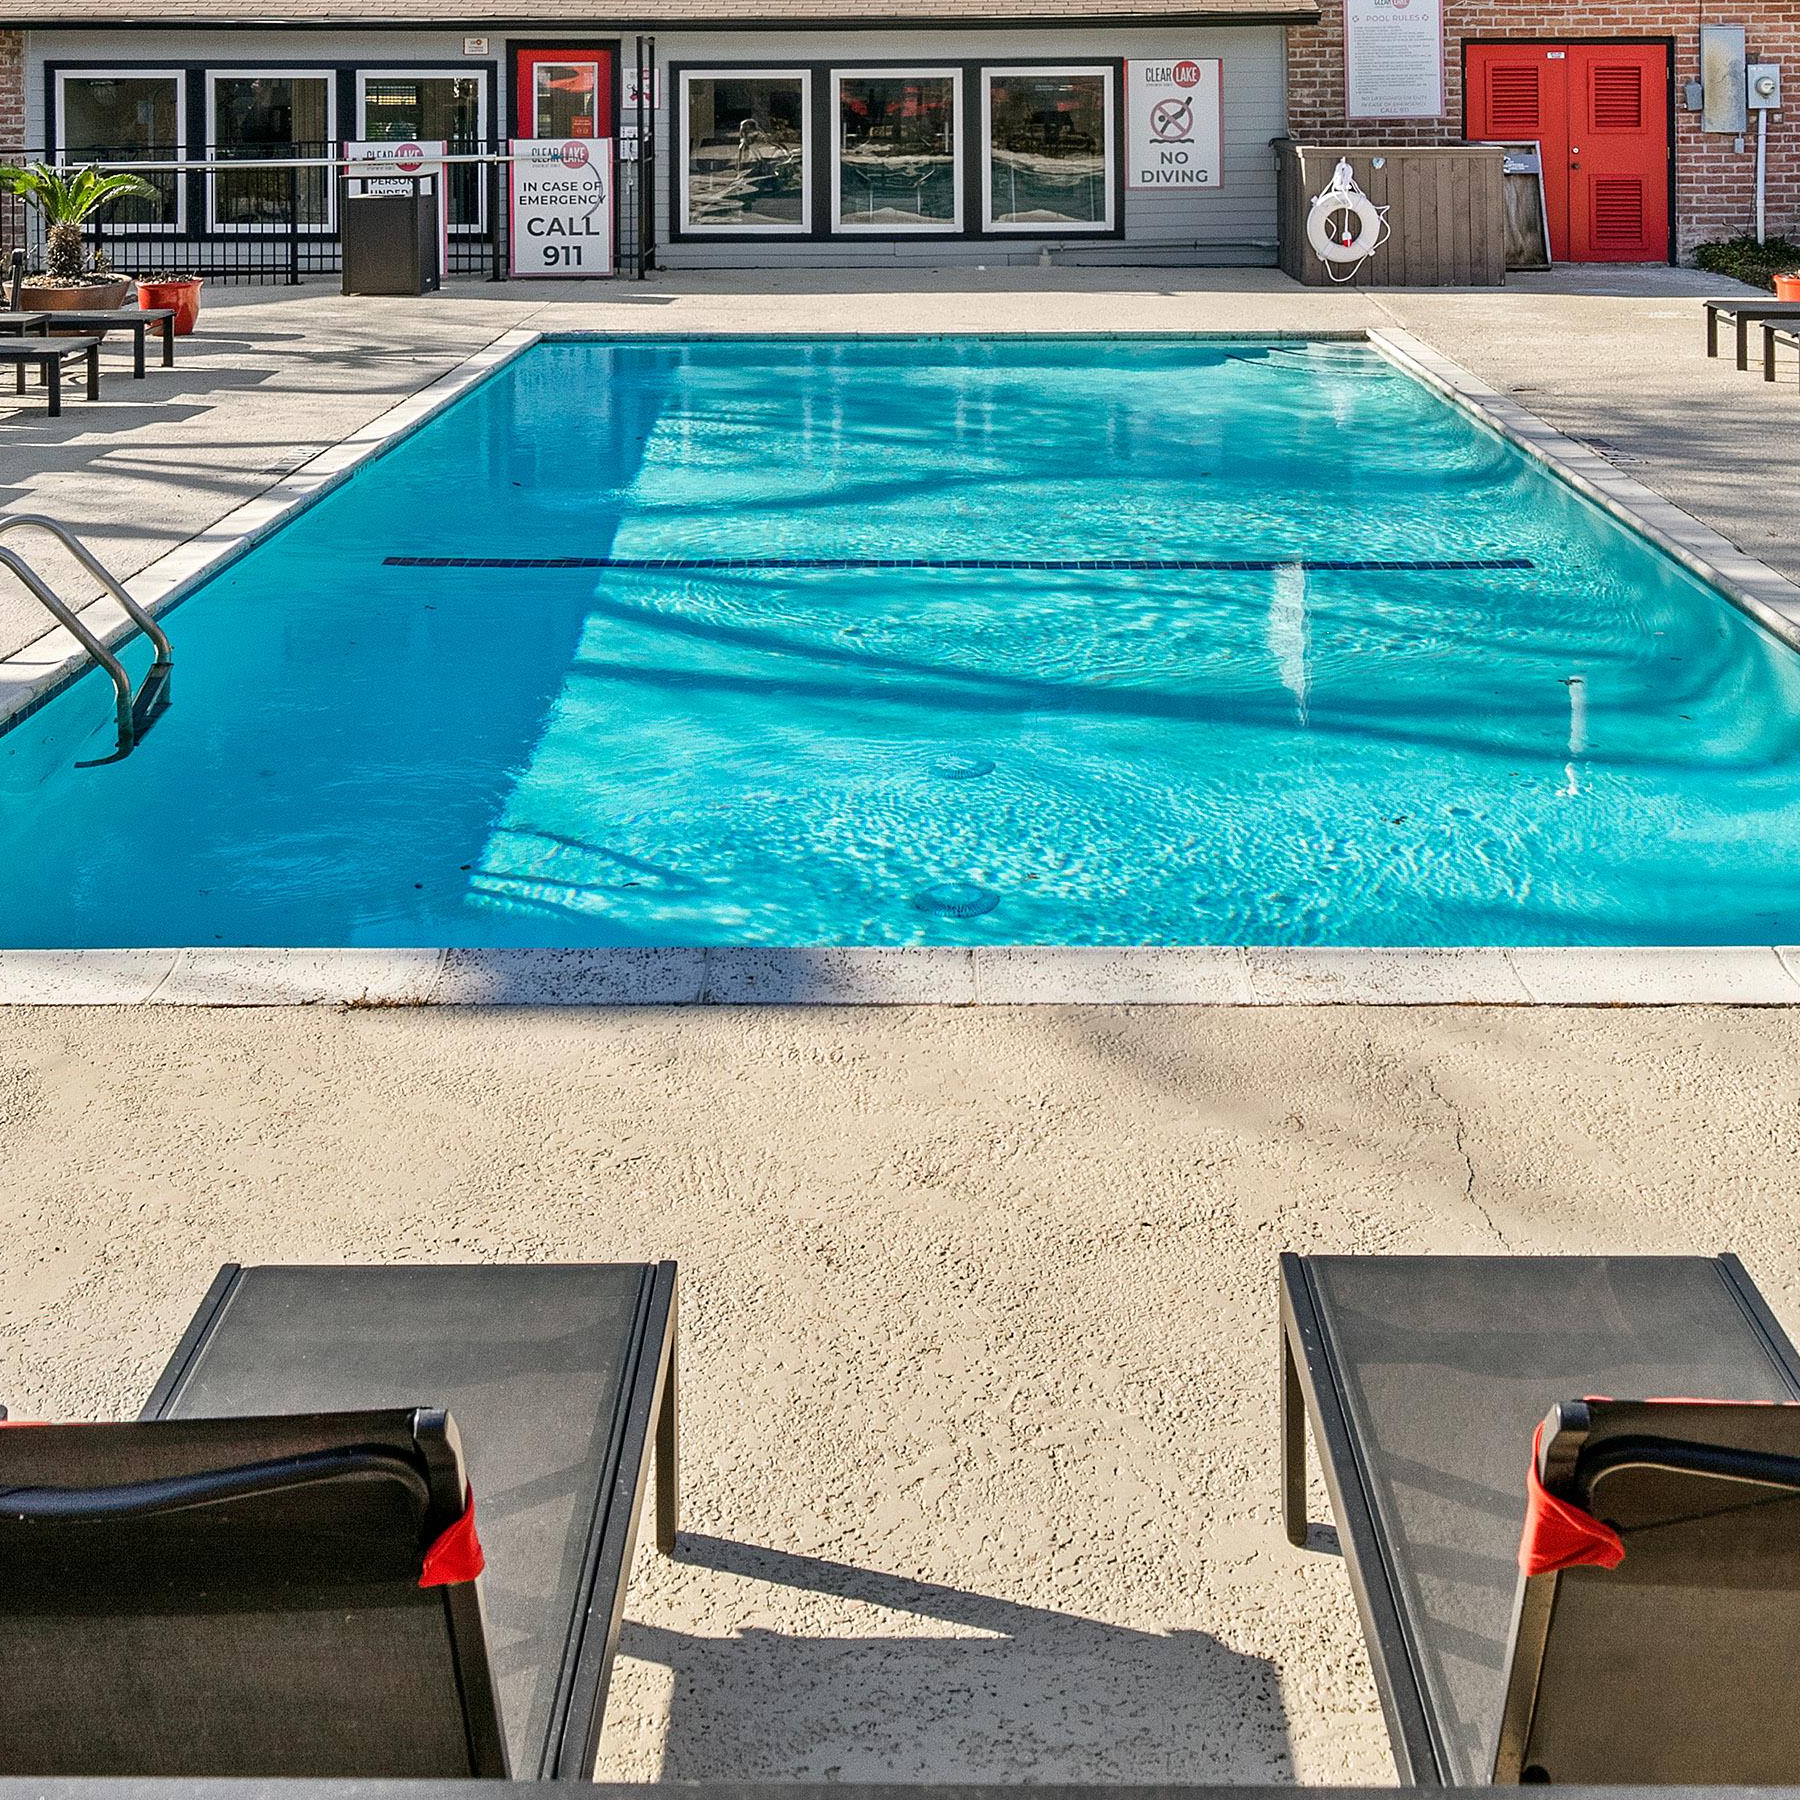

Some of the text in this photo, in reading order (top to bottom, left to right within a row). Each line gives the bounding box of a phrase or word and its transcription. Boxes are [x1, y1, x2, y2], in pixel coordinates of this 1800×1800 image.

[1145, 67, 1198, 82] CLEAR LAKE
[532, 147, 586, 163] CLEAR LAKE
[1160, 151, 1189, 165] NO
[1141, 170, 1208, 183] DIVING
[523, 182, 602, 192] IN CASE OF
[519, 195, 606, 205] EMERGENCY
[527, 217, 600, 236] CALL
[542, 246, 582, 266] 911
